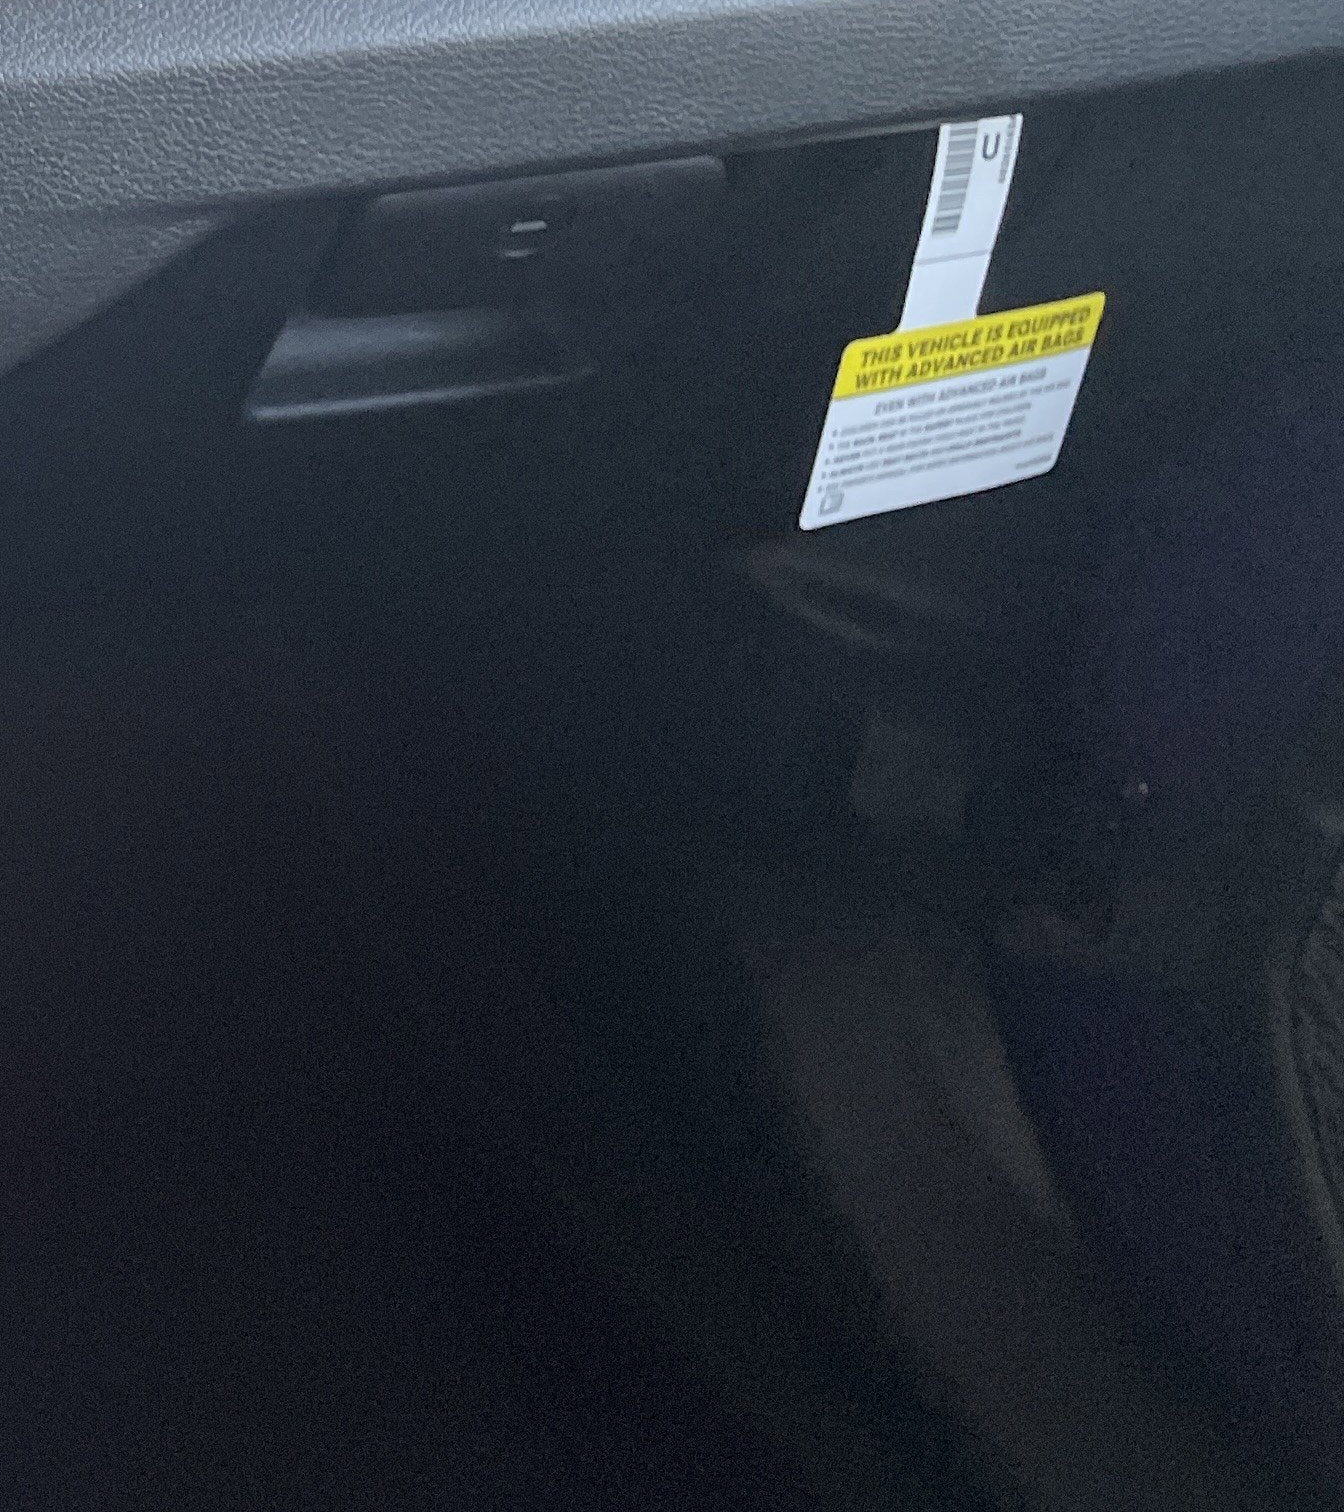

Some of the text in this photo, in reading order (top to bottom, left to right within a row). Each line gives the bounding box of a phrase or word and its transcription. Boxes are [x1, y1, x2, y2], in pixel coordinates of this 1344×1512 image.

[855, 326, 1085, 390] WITH ADVANCED AIR BAGS
[862, 306, 1091, 368] THIS VEHICLE IS EQUIPPED
